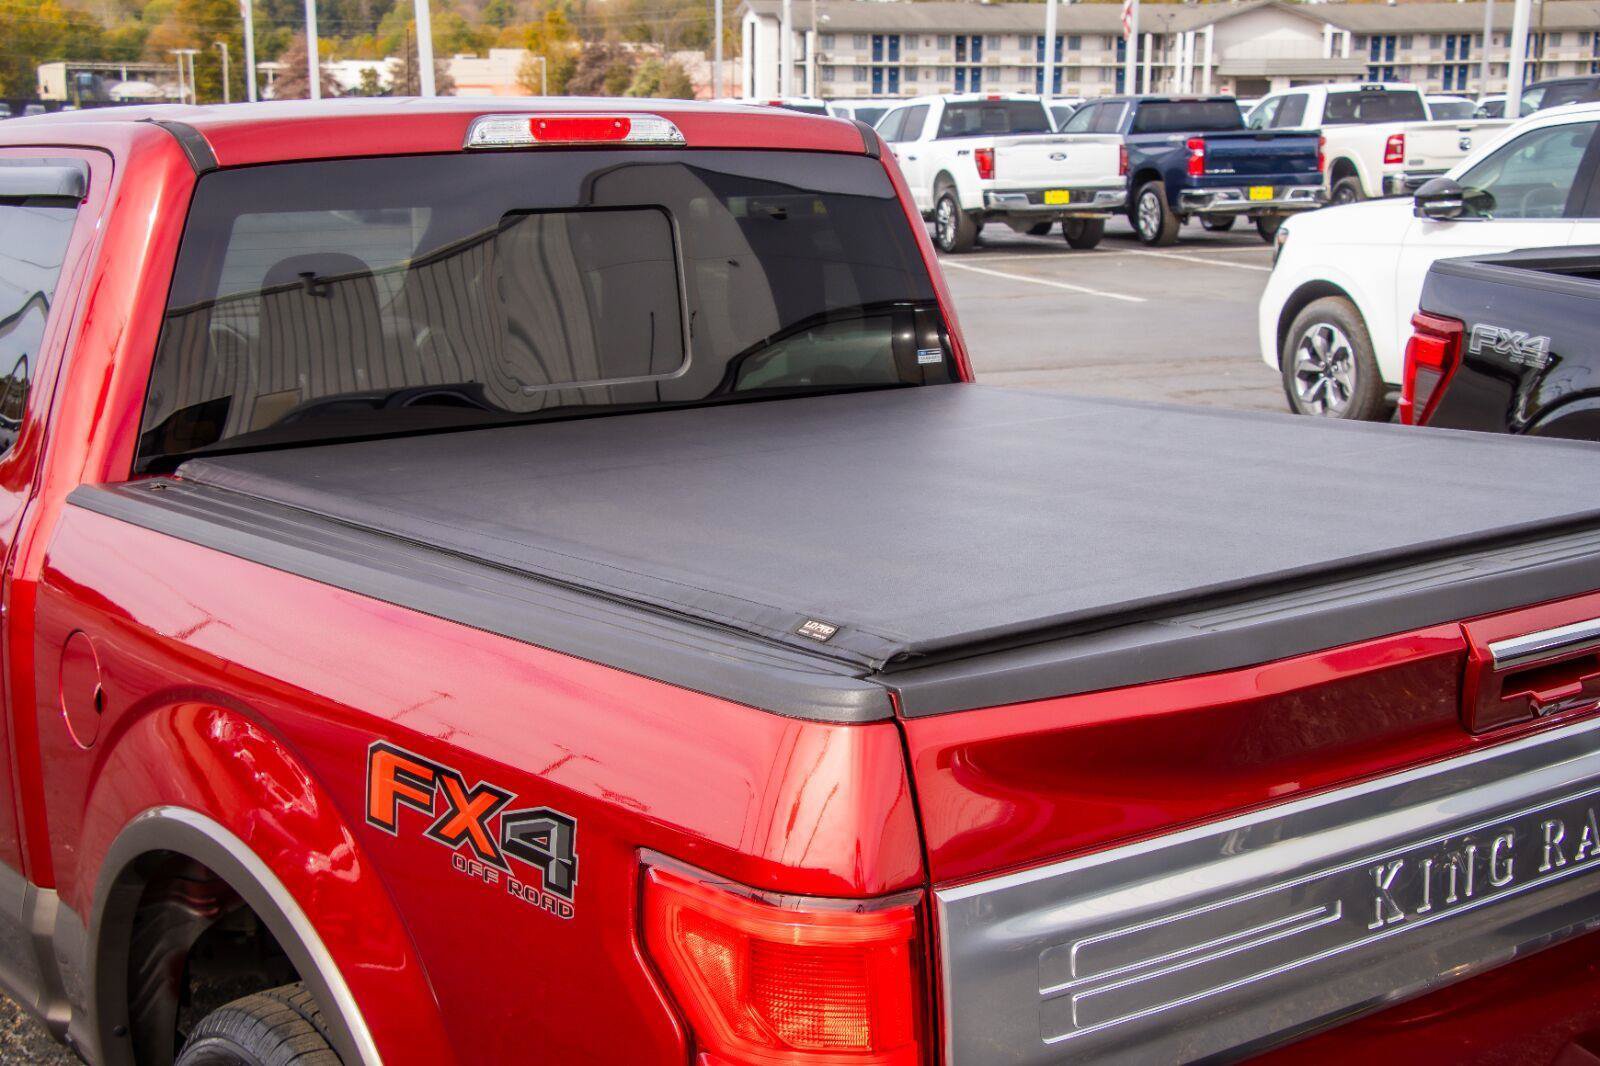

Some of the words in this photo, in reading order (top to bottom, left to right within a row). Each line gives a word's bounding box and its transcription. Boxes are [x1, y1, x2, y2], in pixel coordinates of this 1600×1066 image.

[1468, 322, 1552, 366] FX4
[365, 739, 578, 902] FX4
[452, 853, 499, 884] OFF
[507, 876, 575, 919] ROAD
[1367, 829, 1515, 930] KING
[1538, 807, 1600, 872] RA
